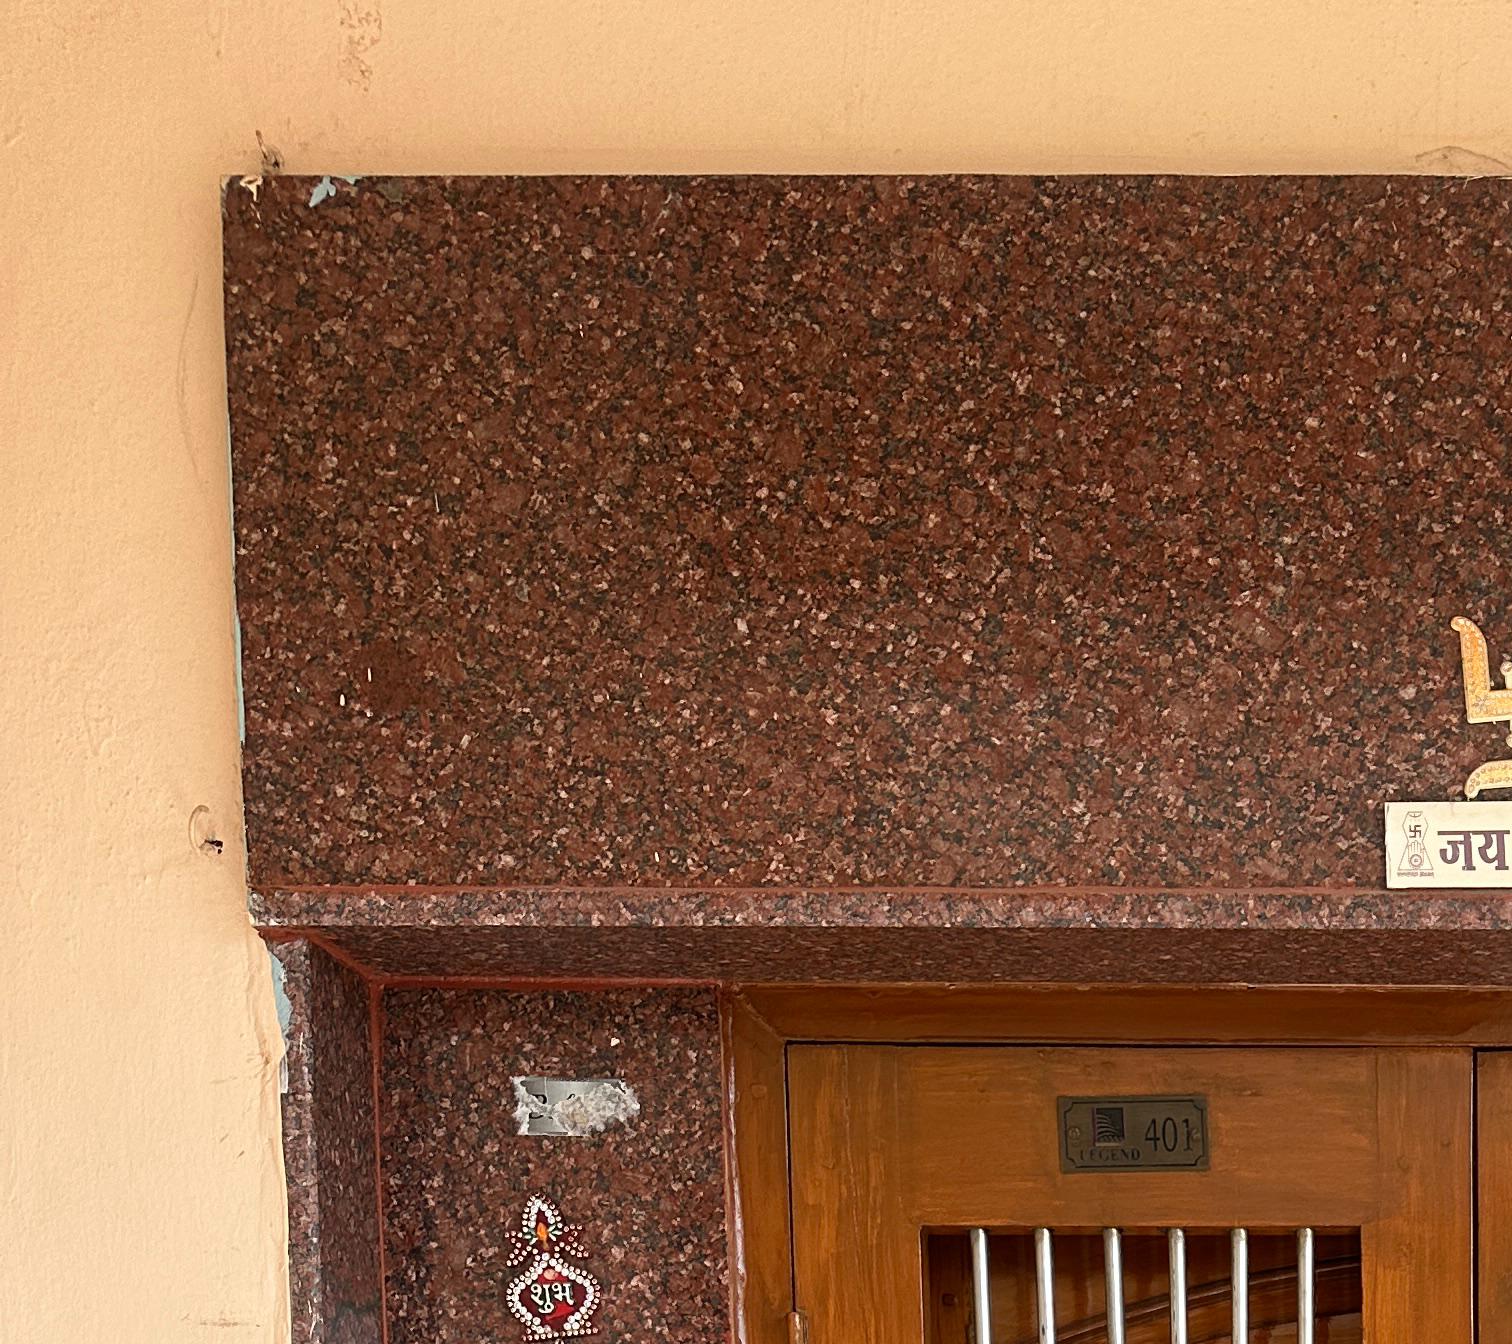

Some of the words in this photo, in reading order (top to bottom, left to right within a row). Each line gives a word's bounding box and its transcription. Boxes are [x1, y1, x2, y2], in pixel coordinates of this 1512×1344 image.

[1437, 829, 1511, 871] जय
[1144, 1116, 1193, 1153] 401
[1079, 1148, 1141, 1162] LEGEND
[529, 1282, 575, 1315] शुभ
